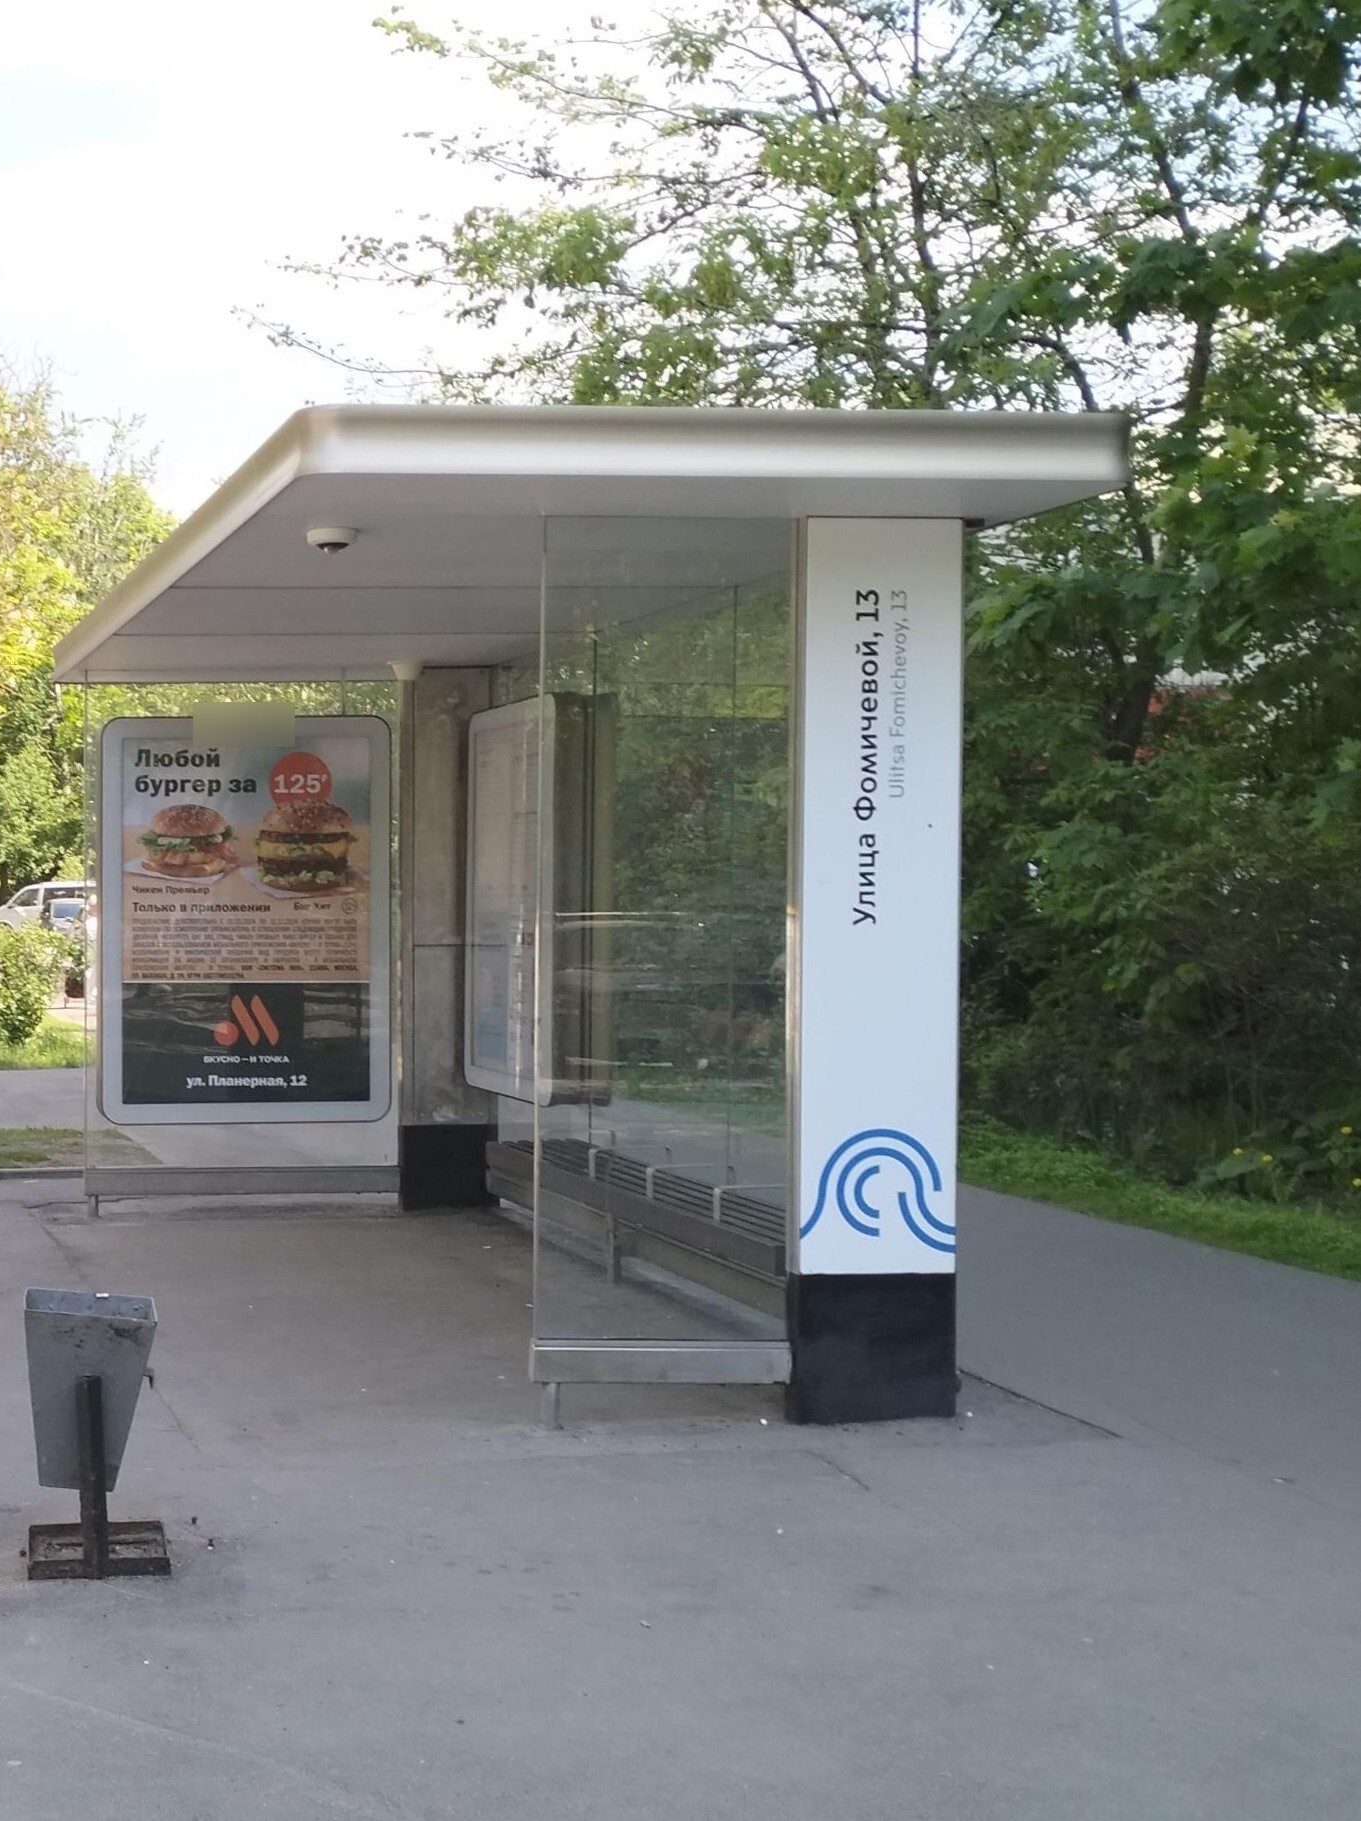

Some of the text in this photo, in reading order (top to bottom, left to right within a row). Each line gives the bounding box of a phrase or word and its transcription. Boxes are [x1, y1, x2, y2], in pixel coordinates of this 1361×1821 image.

[888, 589, 911, 799] Ulitsa Fomichevoy, 13
[134, 747, 221, 768] Любой
[852, 588, 884, 926] Улица Фомичевой, 13
[134, 775, 222, 797] бургер
[228, 778, 258, 794] за
[132, 902, 271, 914] Только в приложении
[258, 1055, 291, 1063] ТОЧКА
[186, 1074, 308, 1089] ул. Планерная, 12
